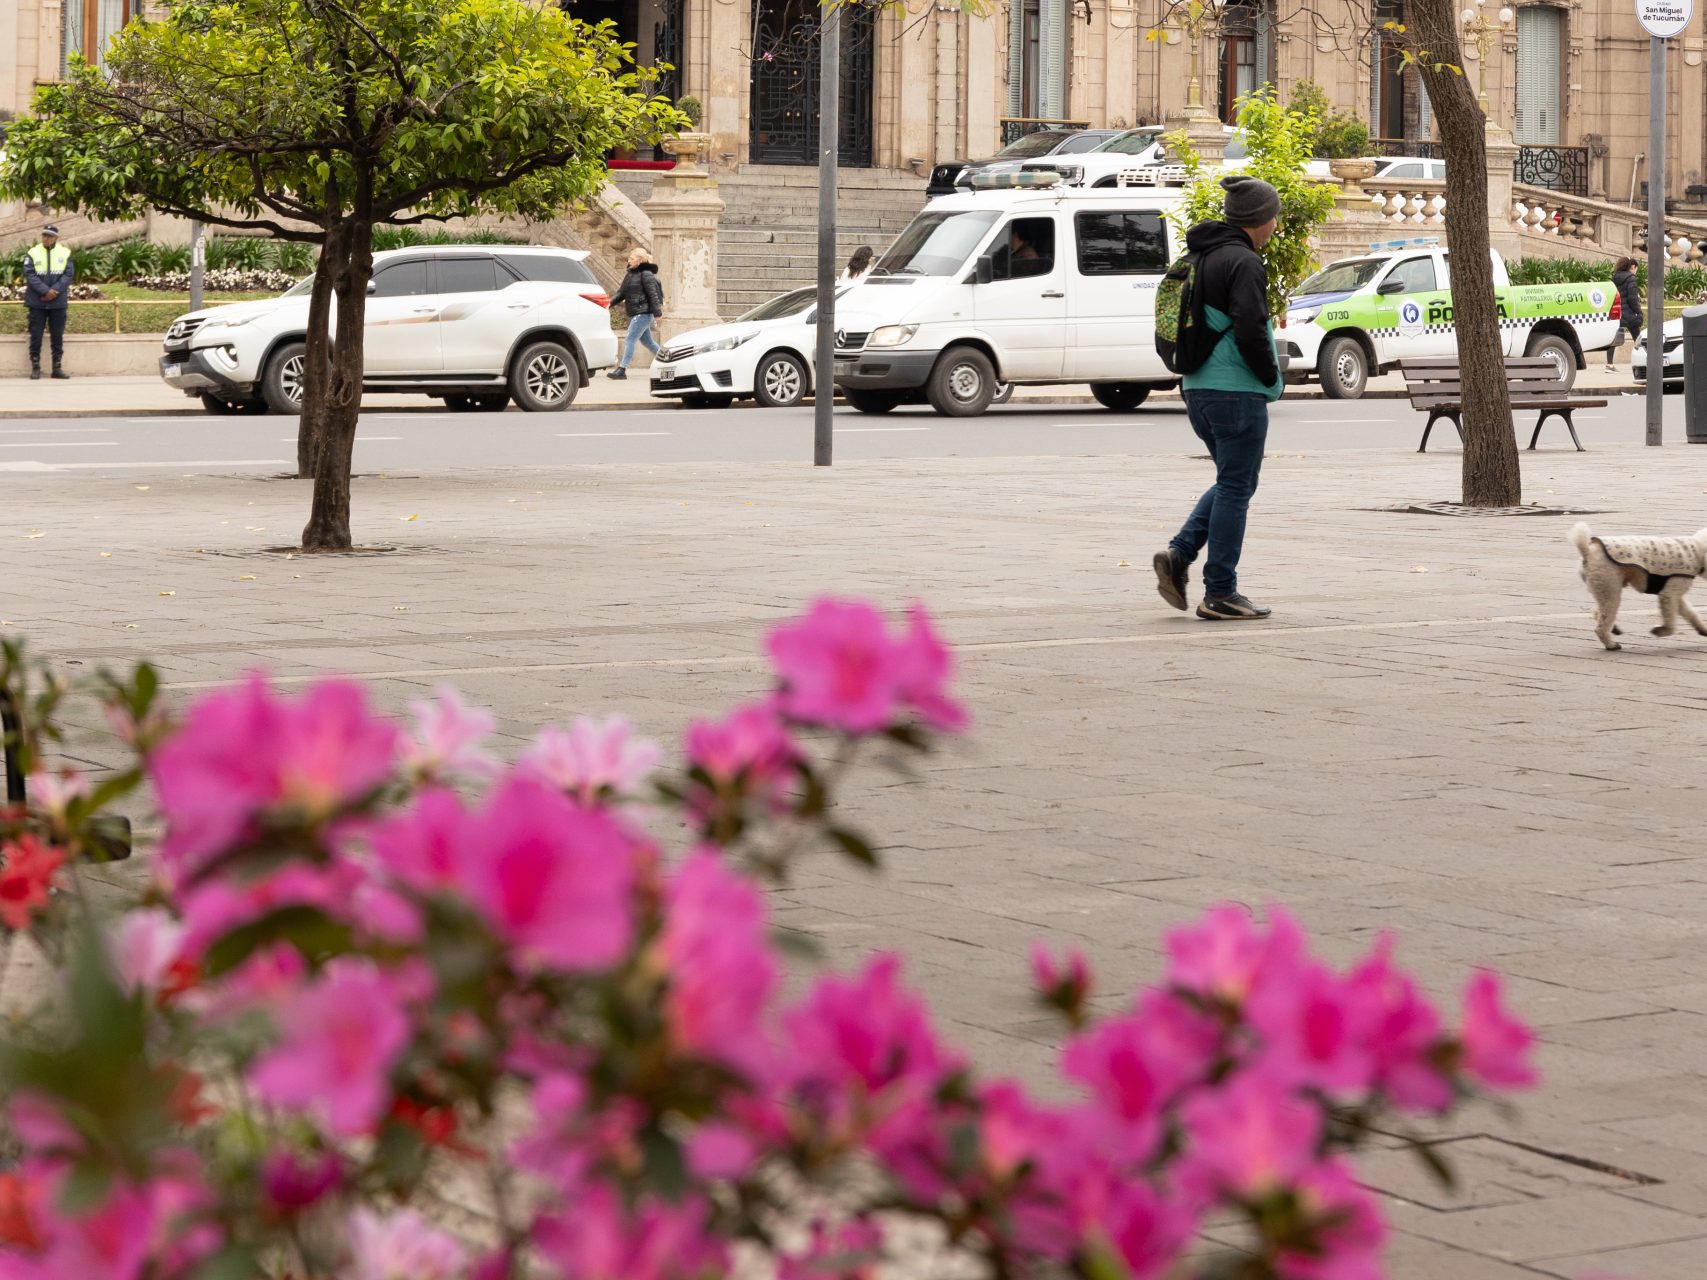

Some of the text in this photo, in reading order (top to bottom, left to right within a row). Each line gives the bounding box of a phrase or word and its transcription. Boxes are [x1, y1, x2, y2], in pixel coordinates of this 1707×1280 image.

[1659, 6, 1682, 15] Miguel
[1652, 14, 1685, 22] Tucumán
[1566, 293, 1583, 303] 911
[1327, 310, 1349, 320] 0730
